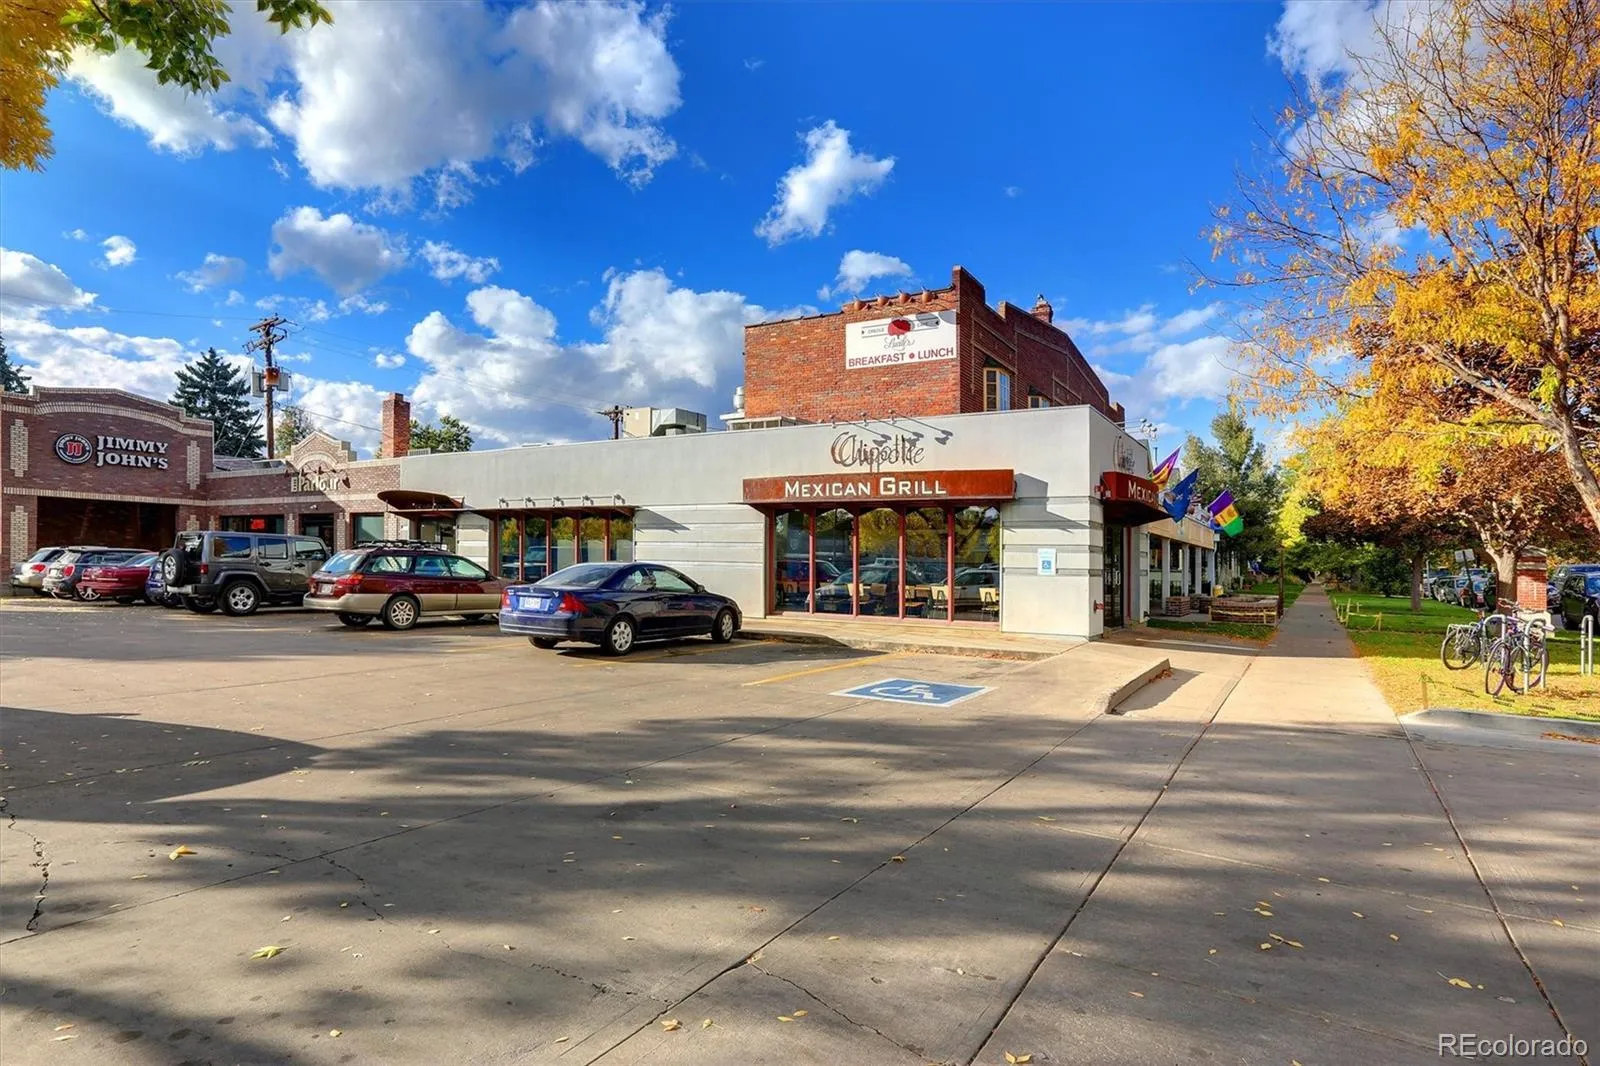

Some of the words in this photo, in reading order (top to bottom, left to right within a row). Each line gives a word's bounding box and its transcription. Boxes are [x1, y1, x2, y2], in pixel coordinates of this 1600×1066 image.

[848, 352, 906, 367] BREAKFAST
[917, 347, 954, 360] LUNCH
[97, 435, 169, 454] JIMMY
[831, 431, 925, 473] Chipotle
[97, 451, 169, 470] JOHN'S
[784, 481, 871, 498] MEXICAN
[879, 477, 947, 495] GRILL
